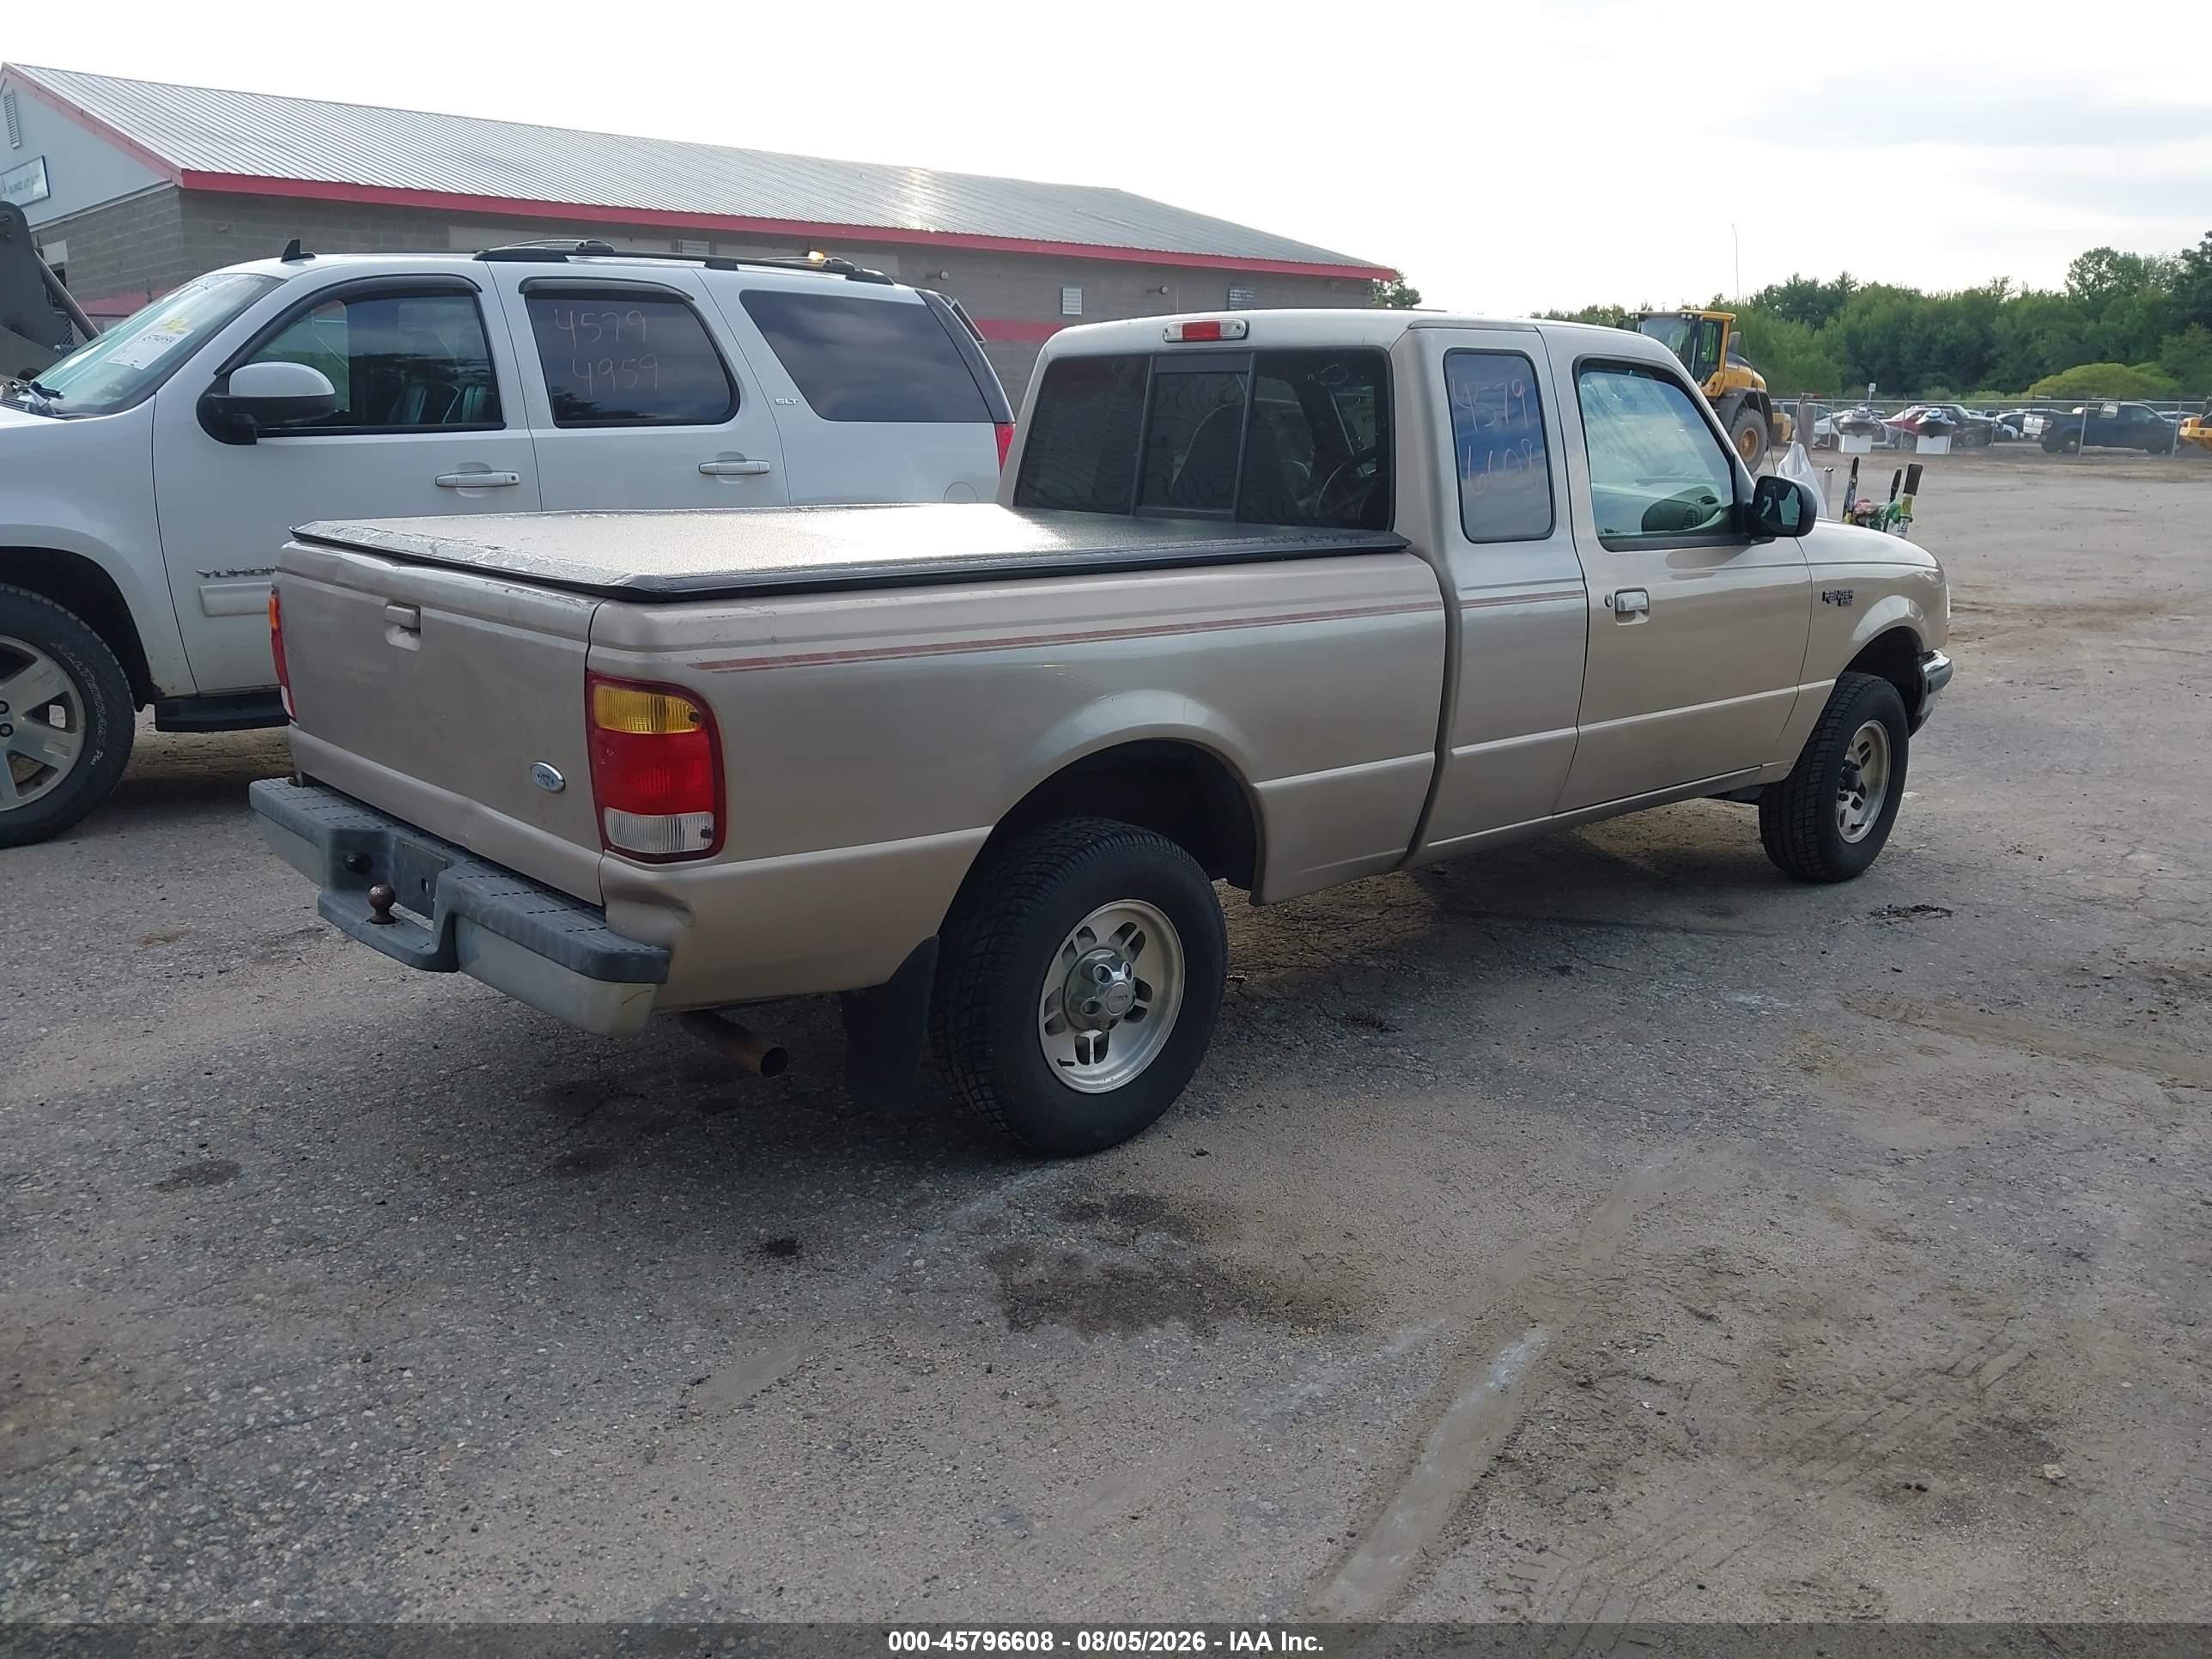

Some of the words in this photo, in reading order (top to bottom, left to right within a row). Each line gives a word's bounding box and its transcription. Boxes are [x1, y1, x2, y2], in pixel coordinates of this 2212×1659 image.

[555, 308, 647, 350] 4579
[571, 354, 659, 396] 4959
[1451, 378, 1529, 432] 4579
[1467, 438, 1540, 495] 6608
